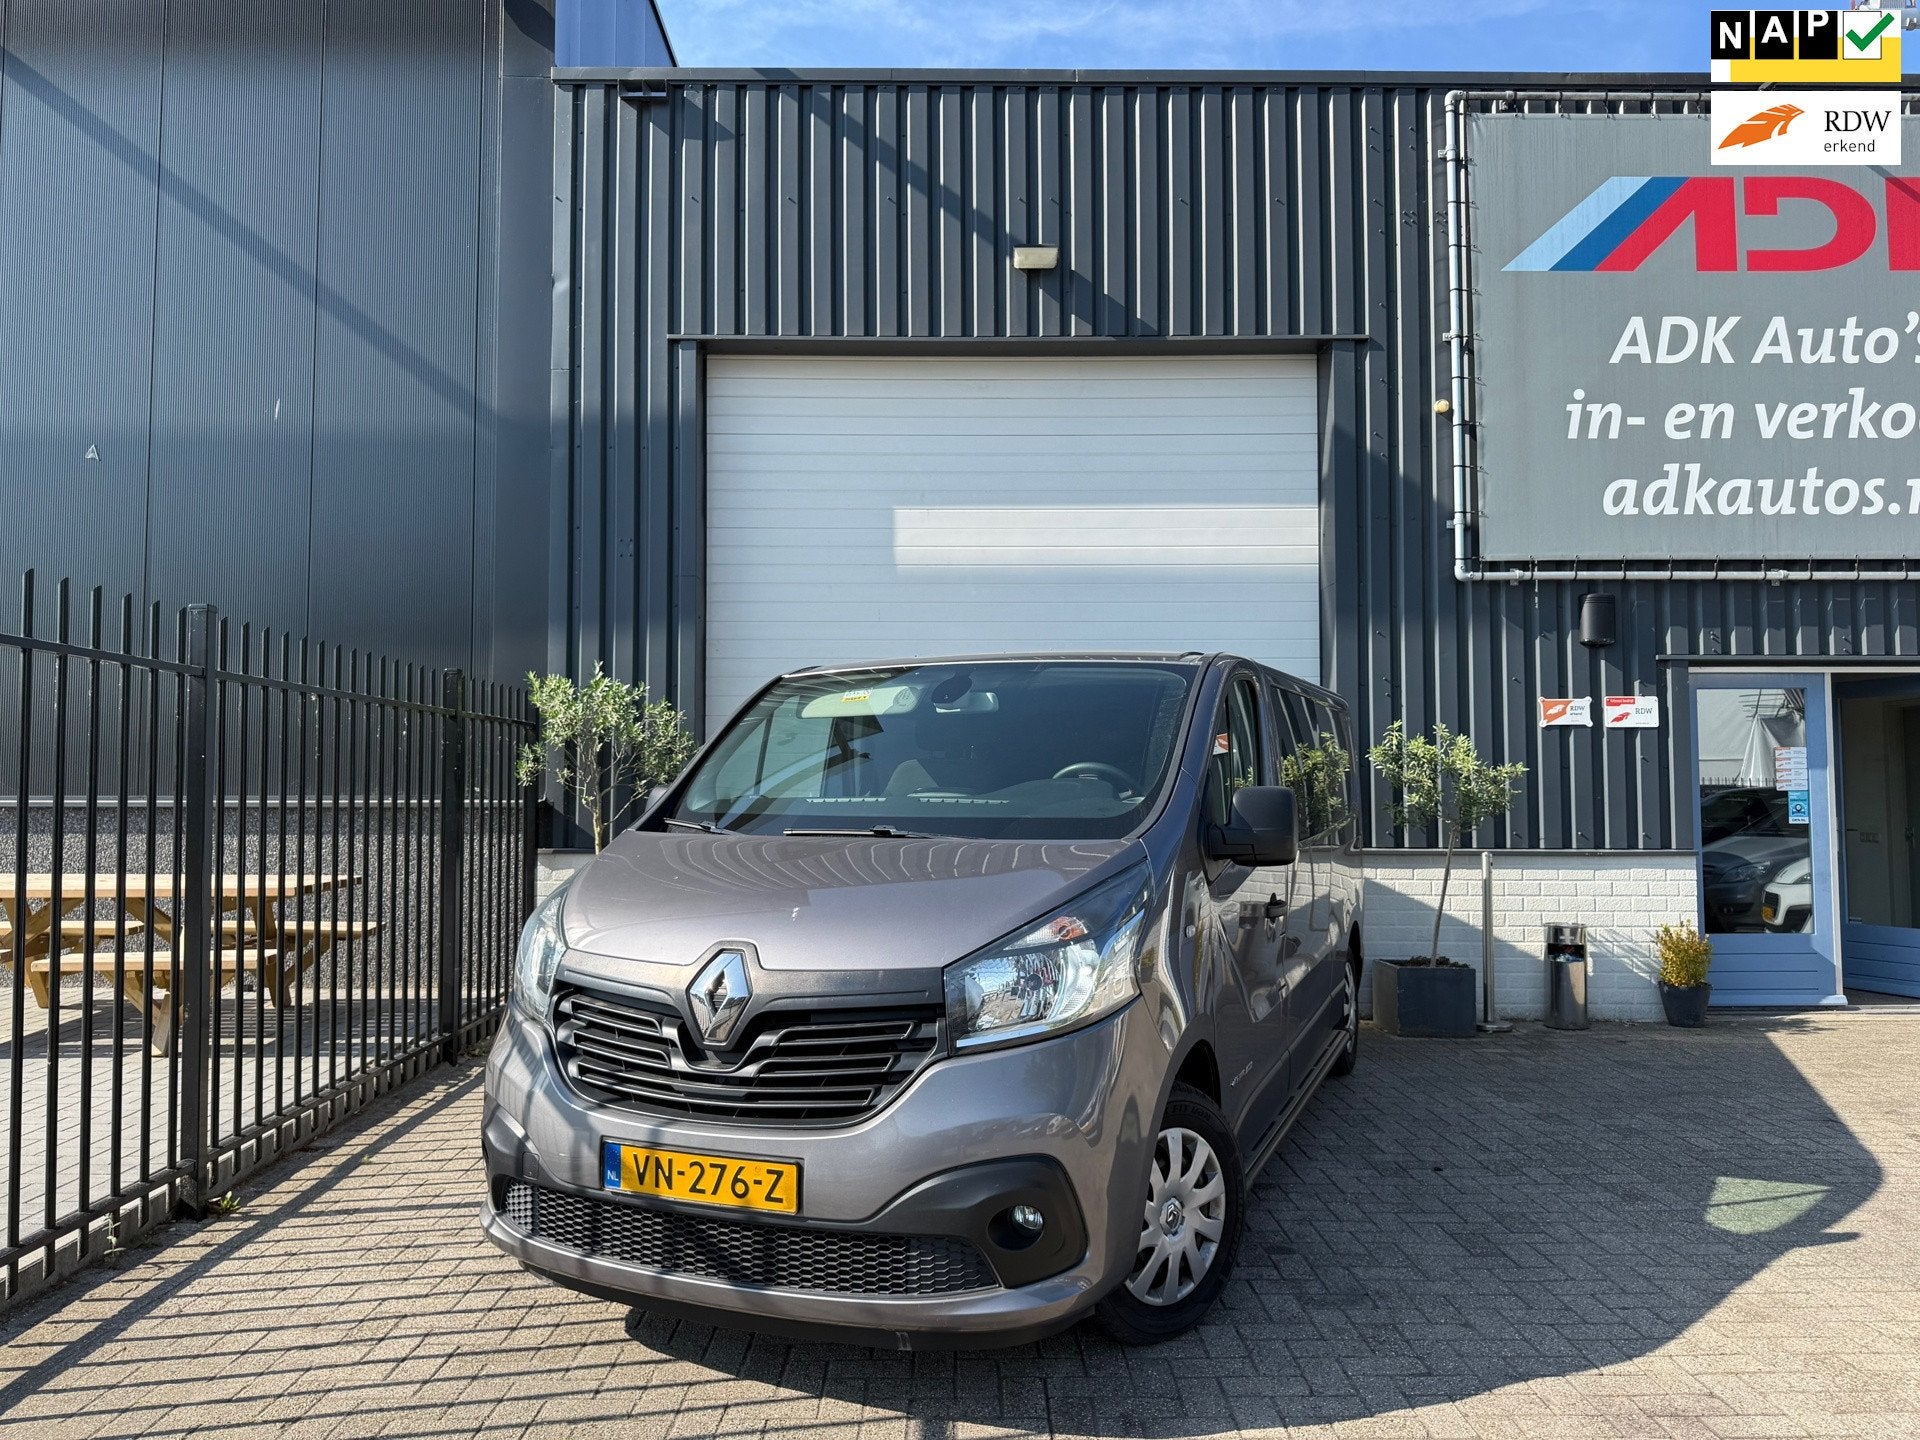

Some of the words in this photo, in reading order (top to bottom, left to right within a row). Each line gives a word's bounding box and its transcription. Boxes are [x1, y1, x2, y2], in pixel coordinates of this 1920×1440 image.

[1608, 315, 1742, 364] ADK
[1751, 310, 1920, 365] Auto'
[1565, 388, 1646, 440] in-
[1664, 402, 1735, 440] en
[1755, 387, 1920, 440] verko
[607, 1169, 619, 1181] NL
[633, 1153, 785, 1203] VN-276-Z
